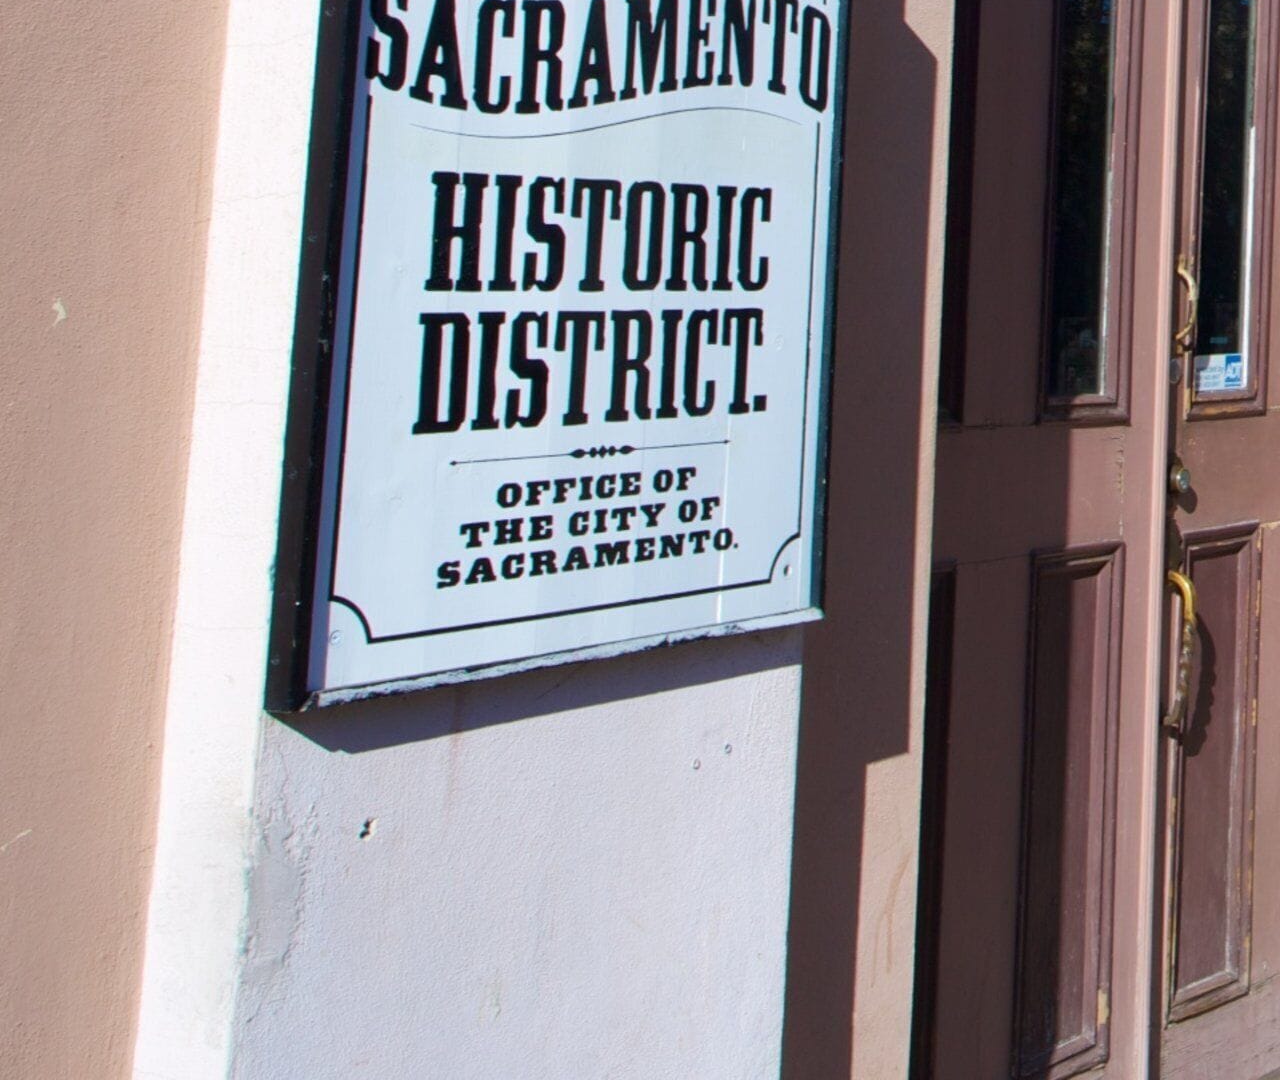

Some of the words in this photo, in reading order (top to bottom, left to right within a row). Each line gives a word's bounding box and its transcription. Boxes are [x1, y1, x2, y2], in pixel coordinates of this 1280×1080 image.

[423, 171, 772, 294] HISTORIC
[412, 307, 768, 435] DISTRICT.
[496, 471, 642, 510] OFFICE
[652, 465, 697, 495] OF
[460, 514, 553, 550] THE
[568, 503, 670, 541] CITY
[678, 495, 721, 525] OF
[436, 529, 739, 589] SACRAMENTO.
